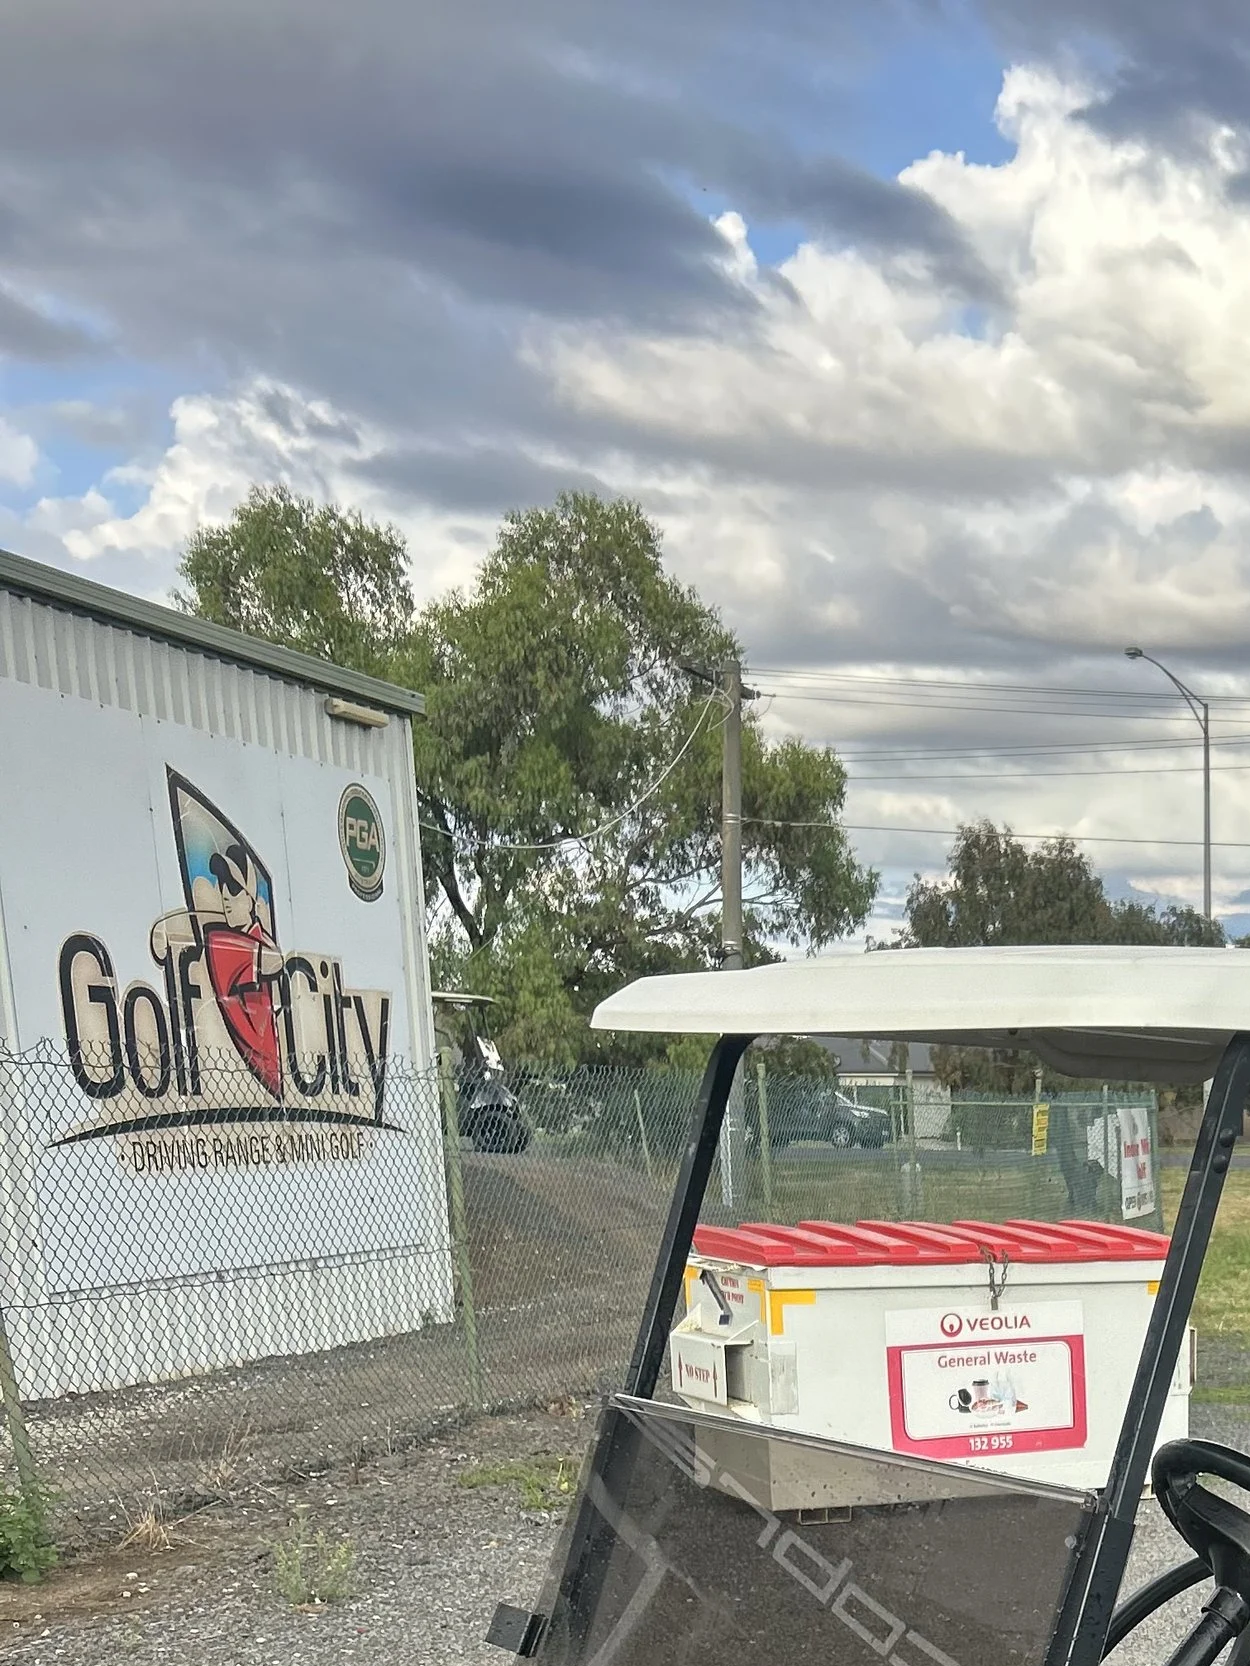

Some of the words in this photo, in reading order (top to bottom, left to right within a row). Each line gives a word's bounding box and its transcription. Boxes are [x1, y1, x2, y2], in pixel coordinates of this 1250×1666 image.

[346, 816, 380, 852] PGA
[59, 934, 203, 1099] Golf
[284, 957, 389, 1120] City
[132, 1138, 208, 1172] DRIVING
[212, 1136, 271, 1167] RANGE
[275, 1137, 287, 1164] &
[290, 1134, 327, 1163] MINI
[329, 1132, 365, 1160] GOLF
[966, 1315, 1031, 1331] VEOLIA
[937, 1352, 991, 1368] General
[995, 1350, 1037, 1365] Waste
[685, 1363, 694, 1378] NO
[695, 1366, 710, 1383] STEP
[969, 1436, 989, 1451] 132
[991, 1434, 1013, 1450] 955
